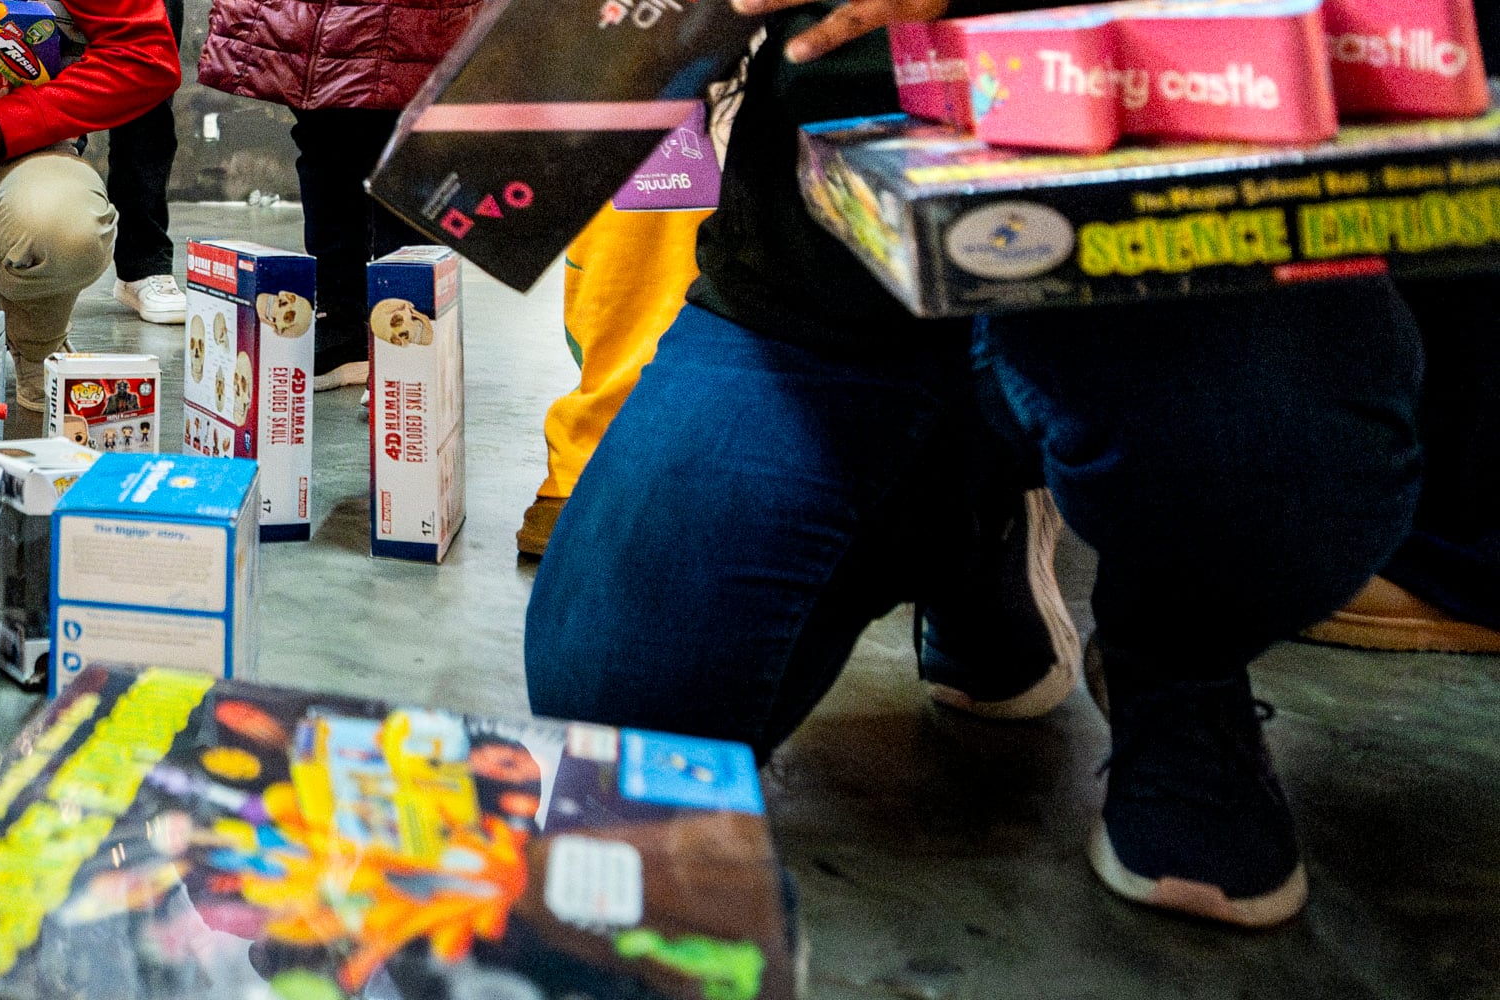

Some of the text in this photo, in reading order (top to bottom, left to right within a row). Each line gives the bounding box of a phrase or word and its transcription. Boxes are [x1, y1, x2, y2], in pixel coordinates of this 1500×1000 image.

[1038, 50, 1112, 95] The
[1160, 60, 1281, 110] castle
[636, 162, 693, 191] gymnic
[1077, 207, 1293, 278] SCIENCE
[49, 376, 58, 434] TRIPLE
[271, 367, 289, 446] EXPLODED SKULL
[295, 396, 306, 445] HUMAN
[385, 380, 397, 431] HUMAN
[405, 382, 423, 463] EXPLODED SKULL
[262, 498, 272, 514] 17
[421, 519, 433, 536] 17
